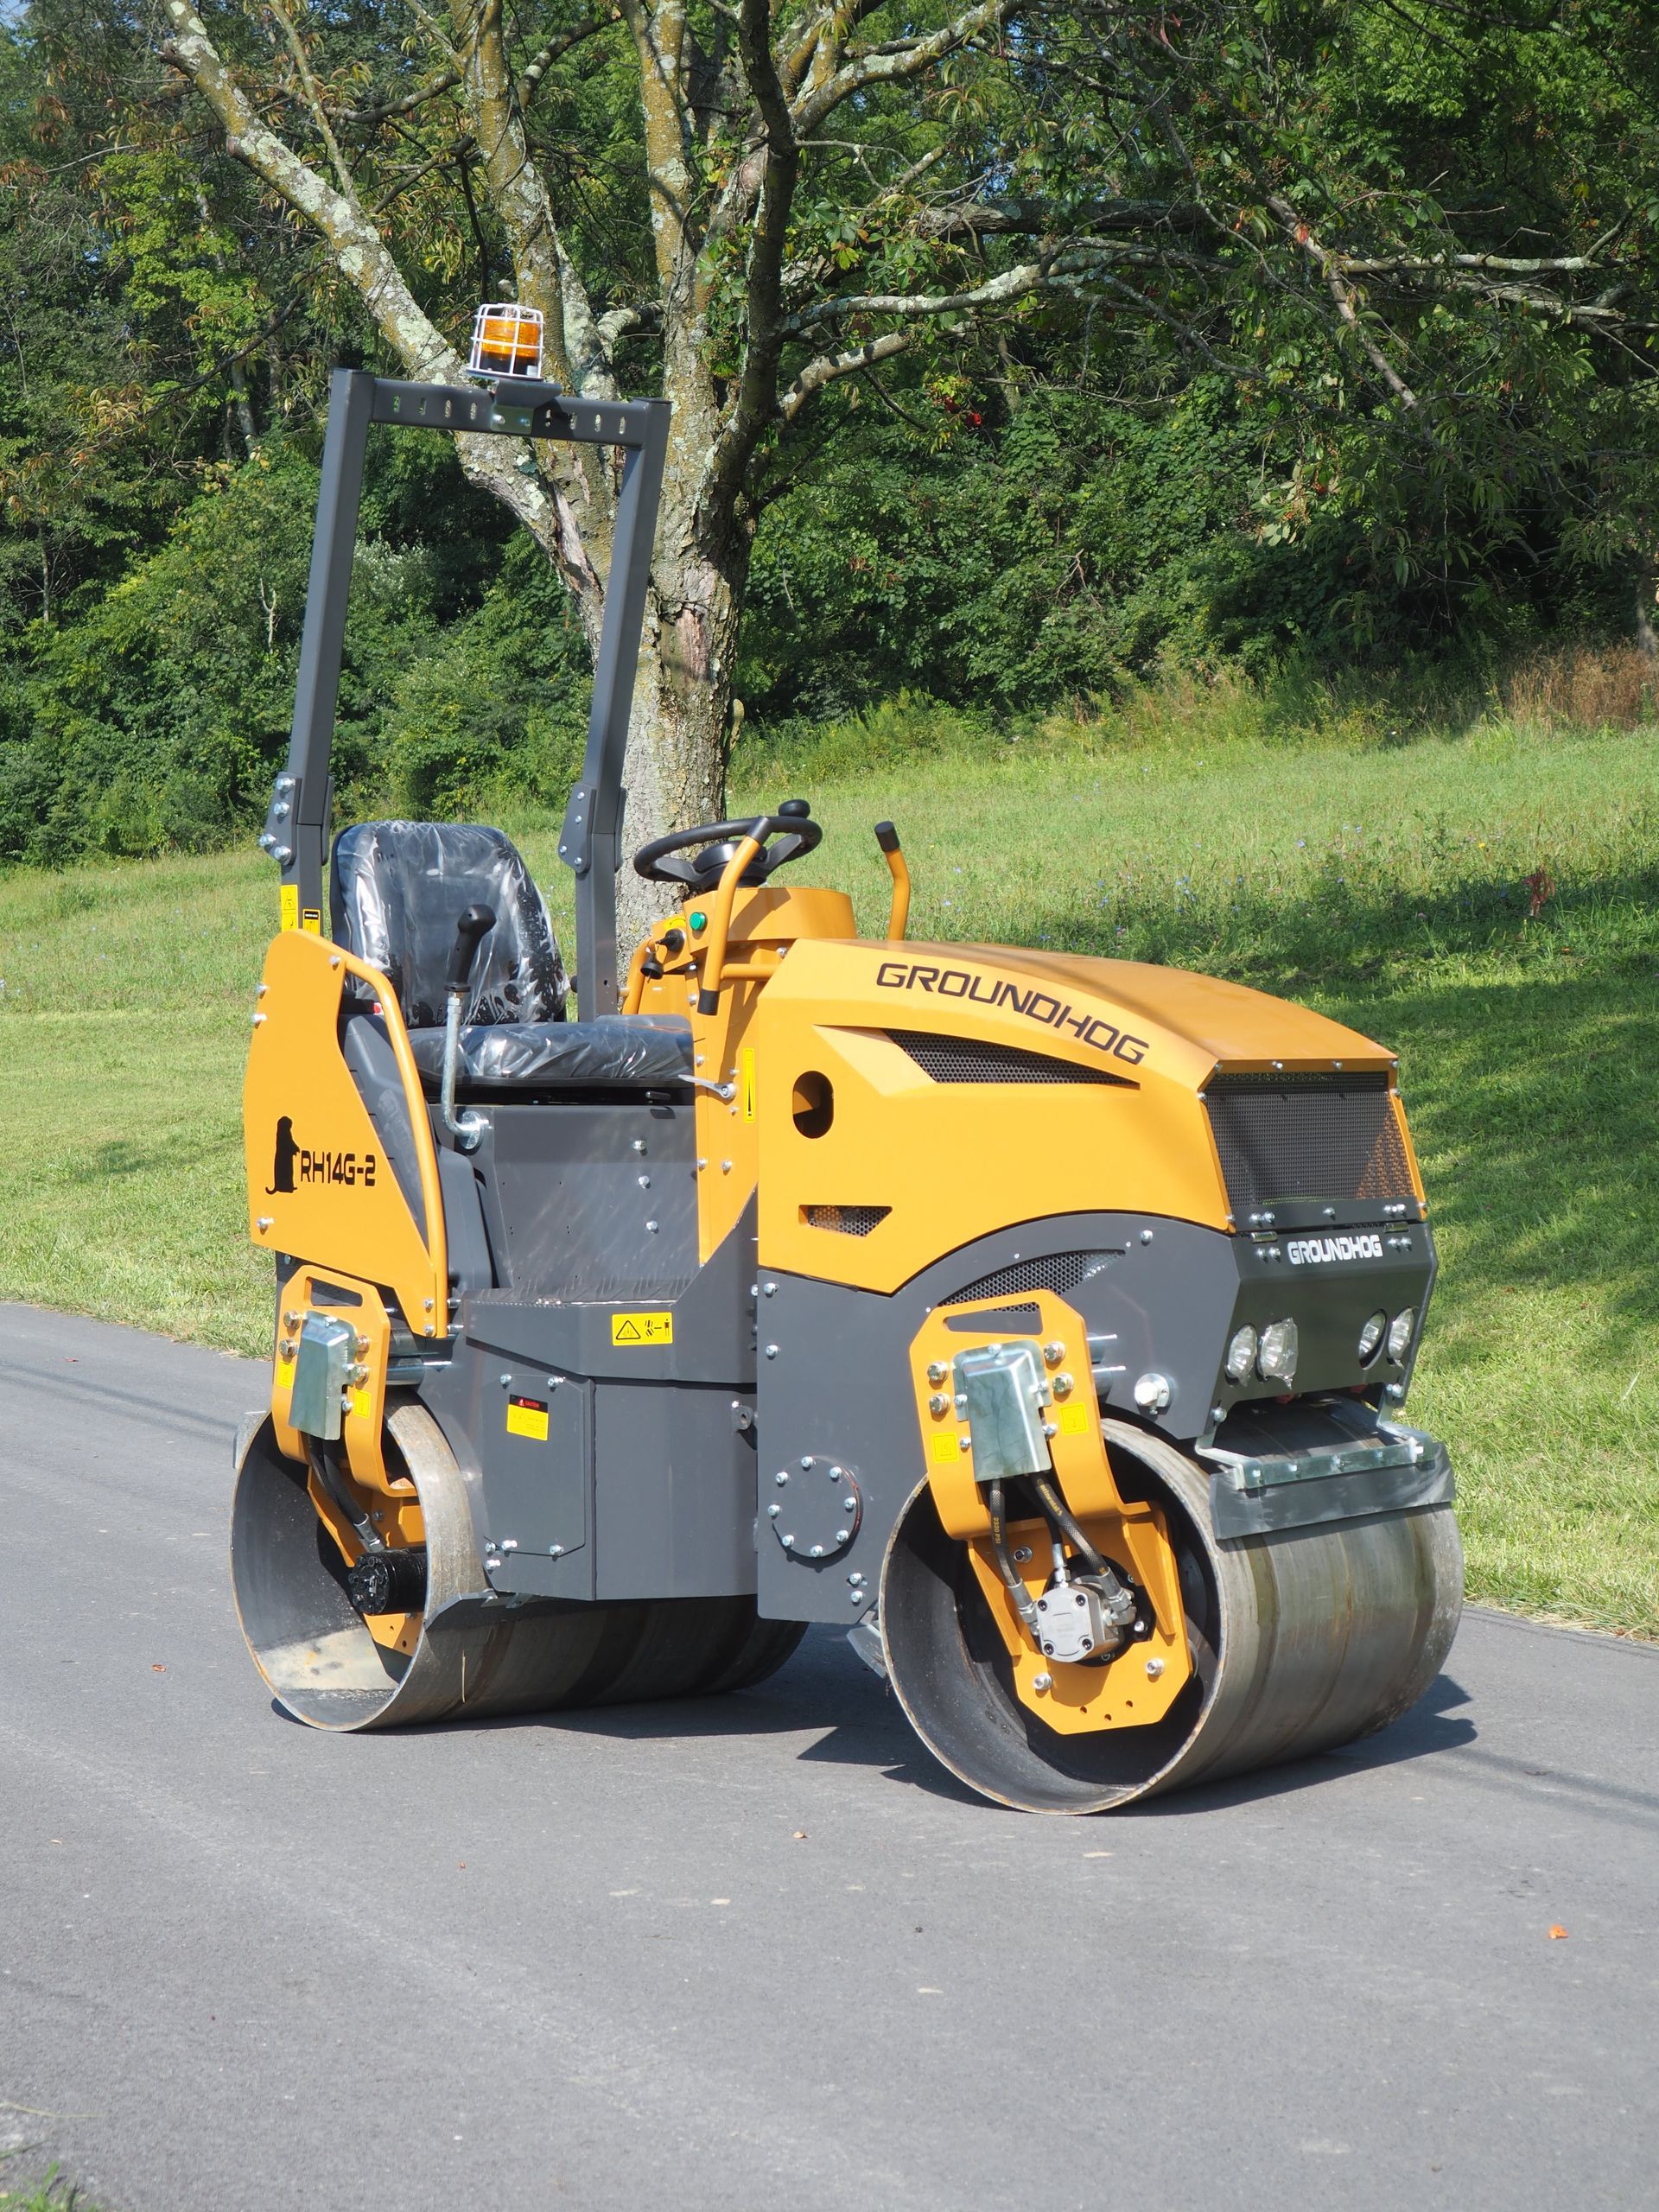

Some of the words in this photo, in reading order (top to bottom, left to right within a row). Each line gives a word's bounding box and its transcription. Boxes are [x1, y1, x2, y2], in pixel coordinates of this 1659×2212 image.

[876, 962, 1150, 1065] GROUNDHOG
[300, 1150, 376, 1187] RH14G-2
[1287, 1234, 1383, 1265] GROUNDHOG
